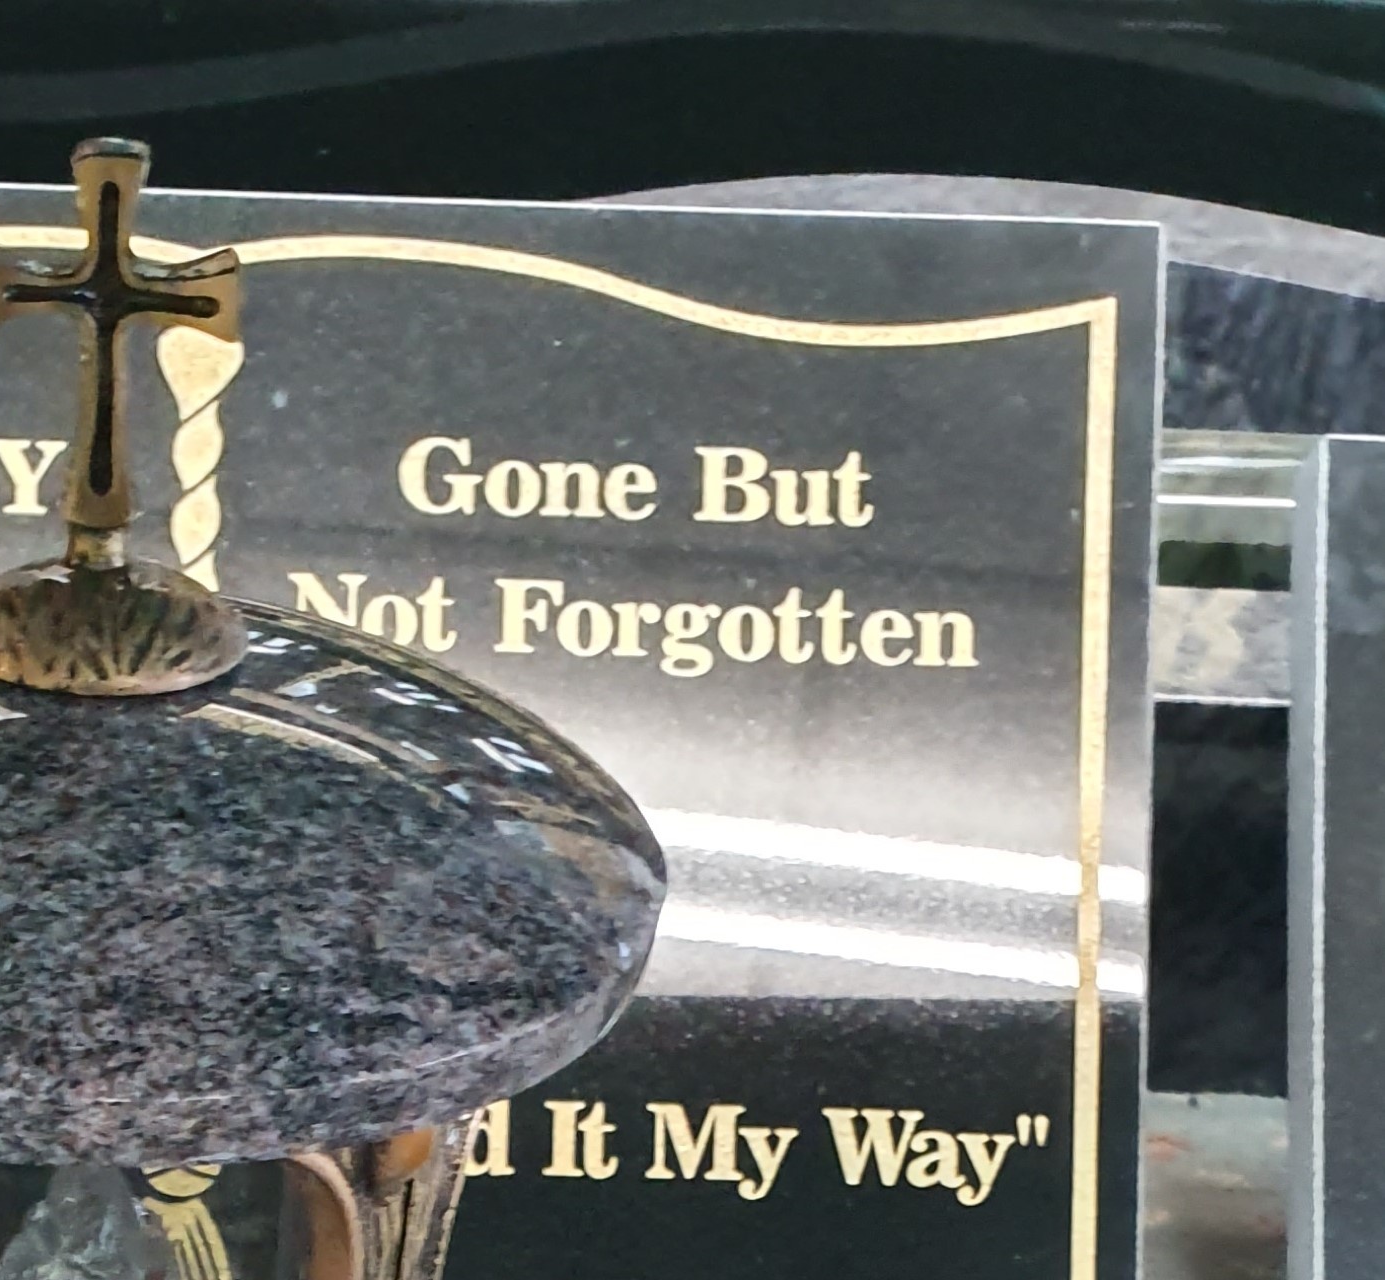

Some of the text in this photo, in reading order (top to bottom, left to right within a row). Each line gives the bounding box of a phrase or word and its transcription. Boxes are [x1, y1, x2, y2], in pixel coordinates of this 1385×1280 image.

[398, 435, 875, 528] Gone But
[286, 571, 980, 677] Not Forgotten
[542, 1099, 618, 1179] It
[645, 1102, 799, 1199] My
[822, 1108, 1052, 1206] Way"
